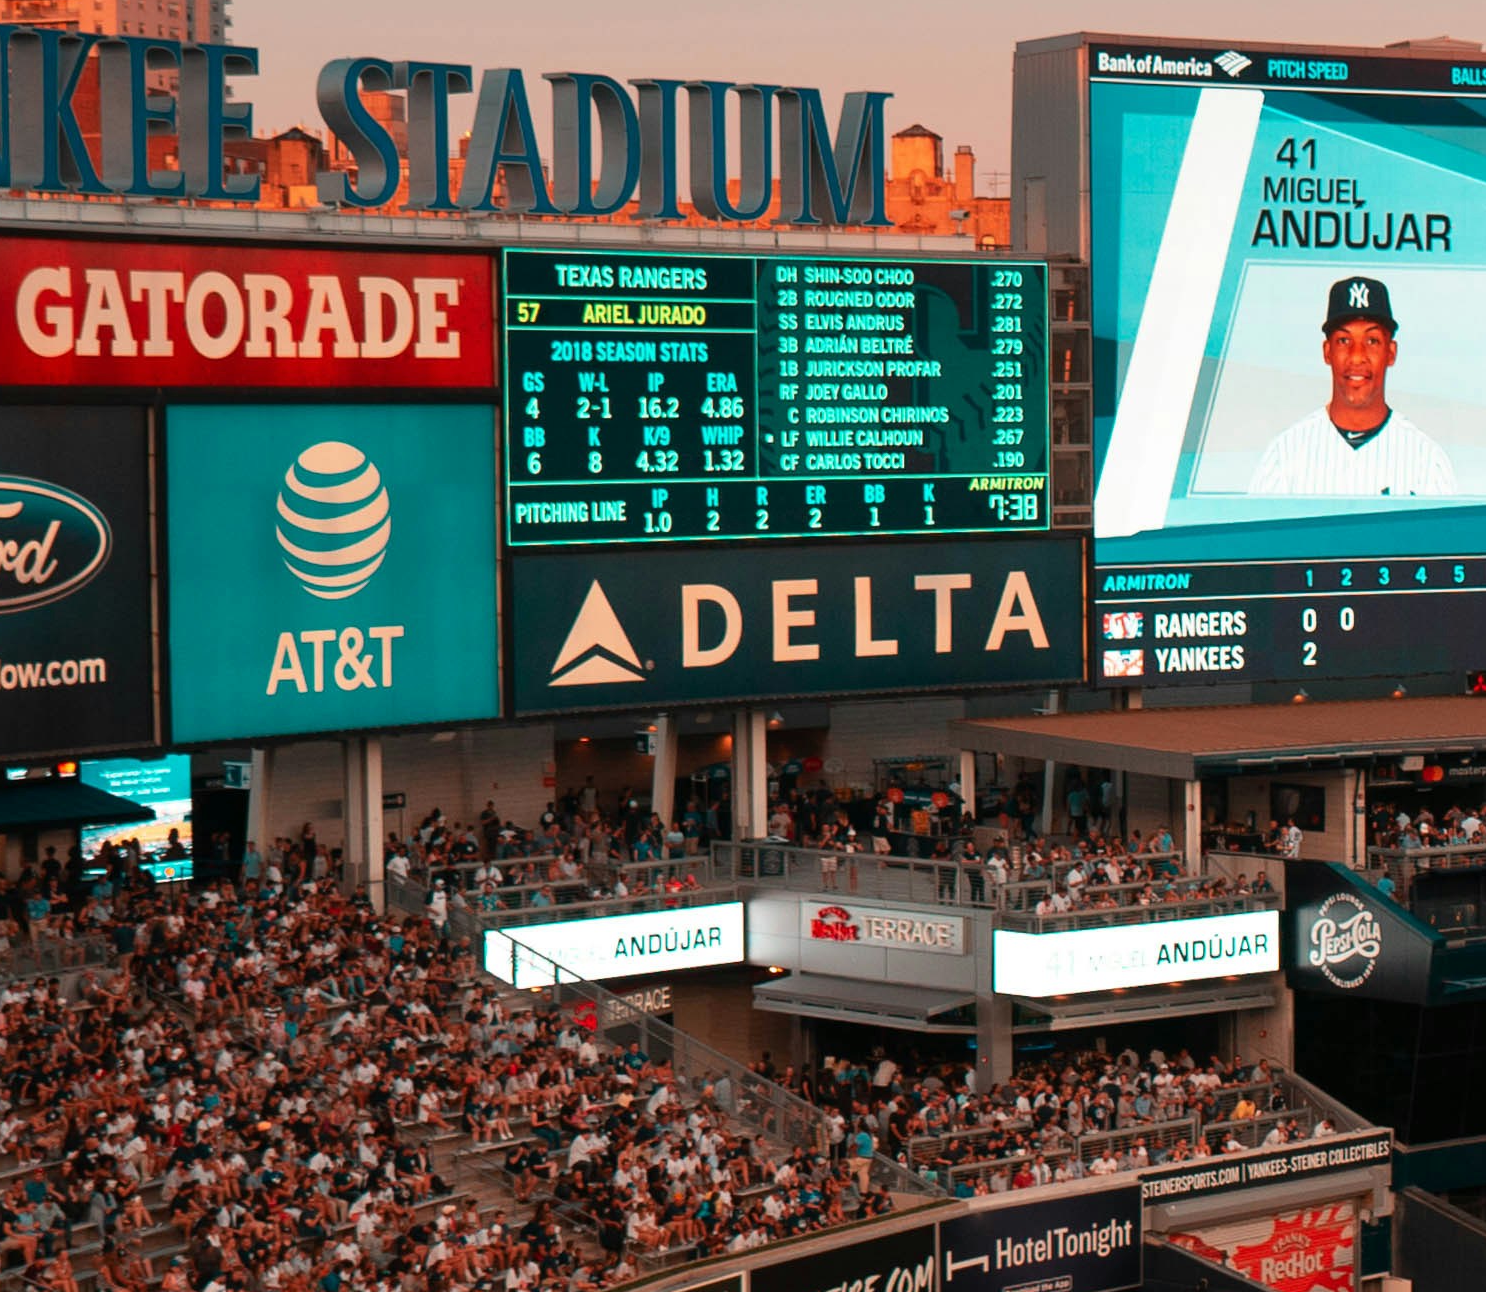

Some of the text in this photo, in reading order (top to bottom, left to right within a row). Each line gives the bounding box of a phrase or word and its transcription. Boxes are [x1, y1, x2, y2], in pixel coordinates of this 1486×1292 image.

[1098, 52, 1212, 76] Bank of America
[1268, 60, 1348, 80] PITCH SPEED
[316, 57, 896, 227] STADIUM
[1276, 138, 1317, 169] 41
[1264, 177, 1361, 203] MIGUEL
[1252, 200, 1452, 251] ANDÚJAR
[556, 265, 708, 290] TEXAS RANGERS
[804, 267, 914, 286] SHIN-SOO CHOO
[16, 266, 462, 361] GATORADE
[517, 302, 706, 326] 57 ARIEL JURADO
[970, 477, 1044, 492] ARMITRON
[988, 494, 1038, 521] 7:38
[680, 570, 1050, 668] DELTA
[1154, 611, 1246, 639] RANGERS
[265, 624, 405, 698] AT&T
[1156, 644, 1244, 673] YANKEES
[860, 915, 955, 948] TERRACE
[1141, 1140, 1390, 1199] STEINERSPORTS.COM YANKEES-STEINER COLLECTIBLES
[996, 1218, 1133, 1270] HotelTonight
[1261, 1250, 1324, 1284] RedHot
